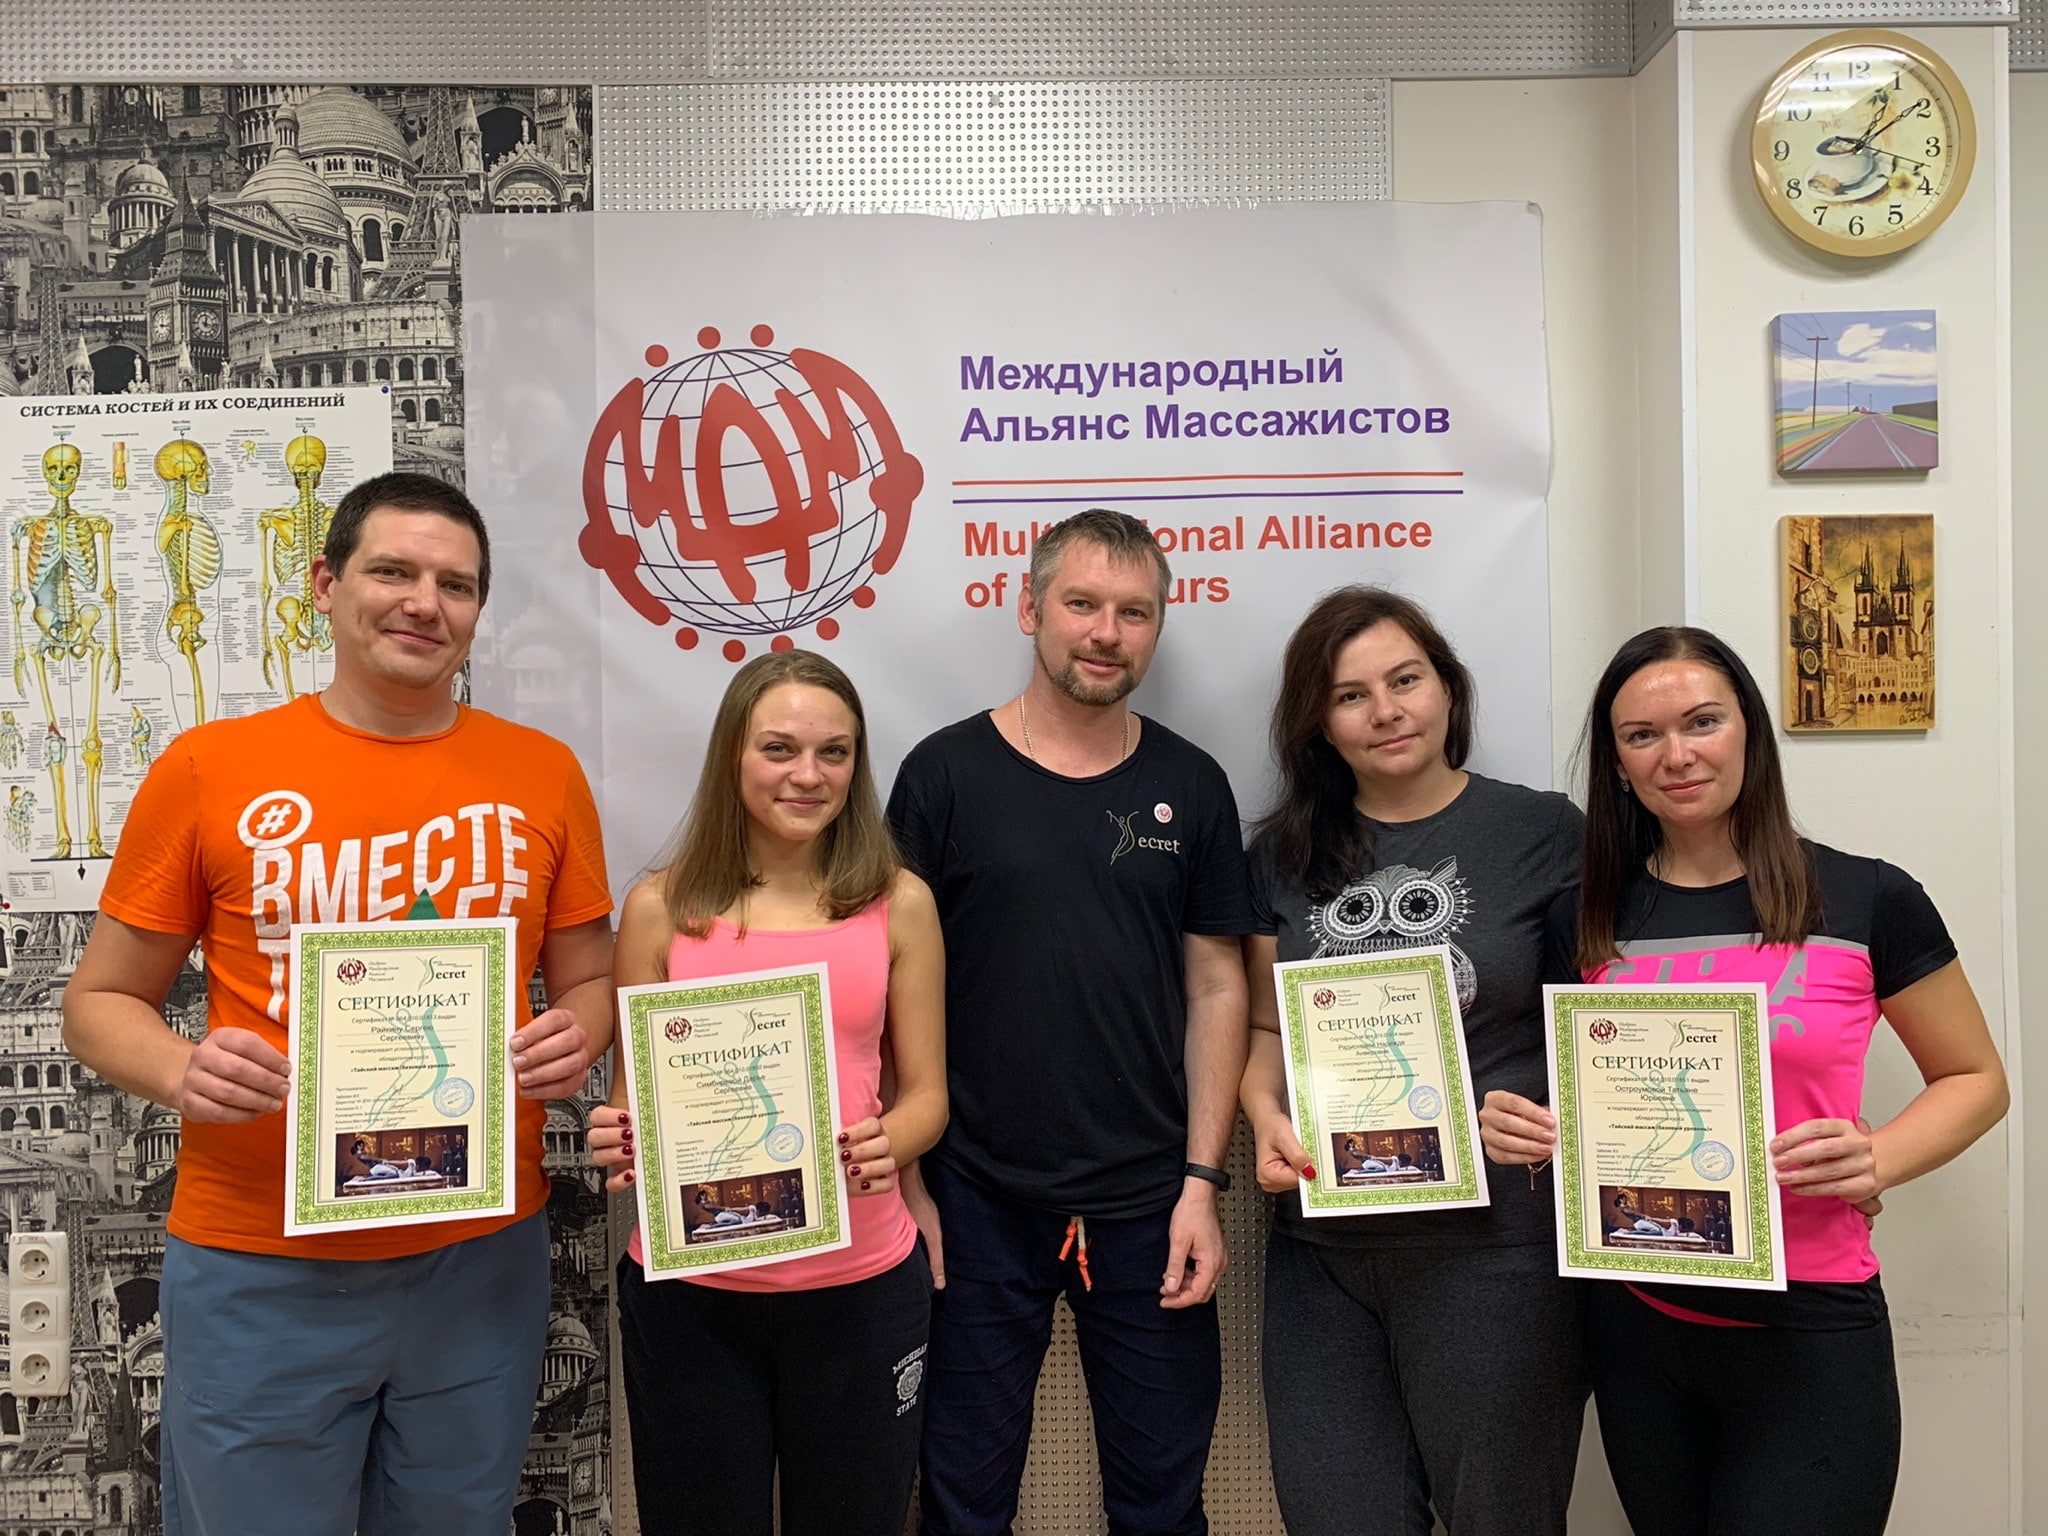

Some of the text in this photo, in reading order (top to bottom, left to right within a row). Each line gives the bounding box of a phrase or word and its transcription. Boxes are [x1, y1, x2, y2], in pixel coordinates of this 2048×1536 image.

[1847, 61, 1871, 79] 12
[1893, 71, 1902, 90] 1
[1812, 72, 1833, 92] 11
[1786, 101, 1812, 122] 10
[1916, 98, 1932, 119] 2
[1774, 140, 1790, 161] 9
[1926, 136, 1941, 157] 3
[1786, 178, 1802, 200] 8
[1917, 176, 1933, 196] 4
[1813, 205, 1829, 226] 7
[1888, 204, 1903, 225] 5
[1849, 216, 1865, 236] 6
[961, 348, 1343, 398] Международный
[20, 392, 345, 418] СИСТЕМА КОСТЕЙ И ИХ СОЕДИНЕНИЙ
[960, 403, 1450, 442] Альянс Массажистов
[1258, 514, 1432, 551] Alliance
[964, 573, 1008, 608] of
[338, 993, 471, 1012] СЕРТИФИКАТ
[1317, 1011, 1423, 1032] СЕРТИФИКАТ
[668, 1040, 792, 1069] СЕРТИФИКАТ
[1592, 1056, 1724, 1071] СЕРТИФИКАТ
